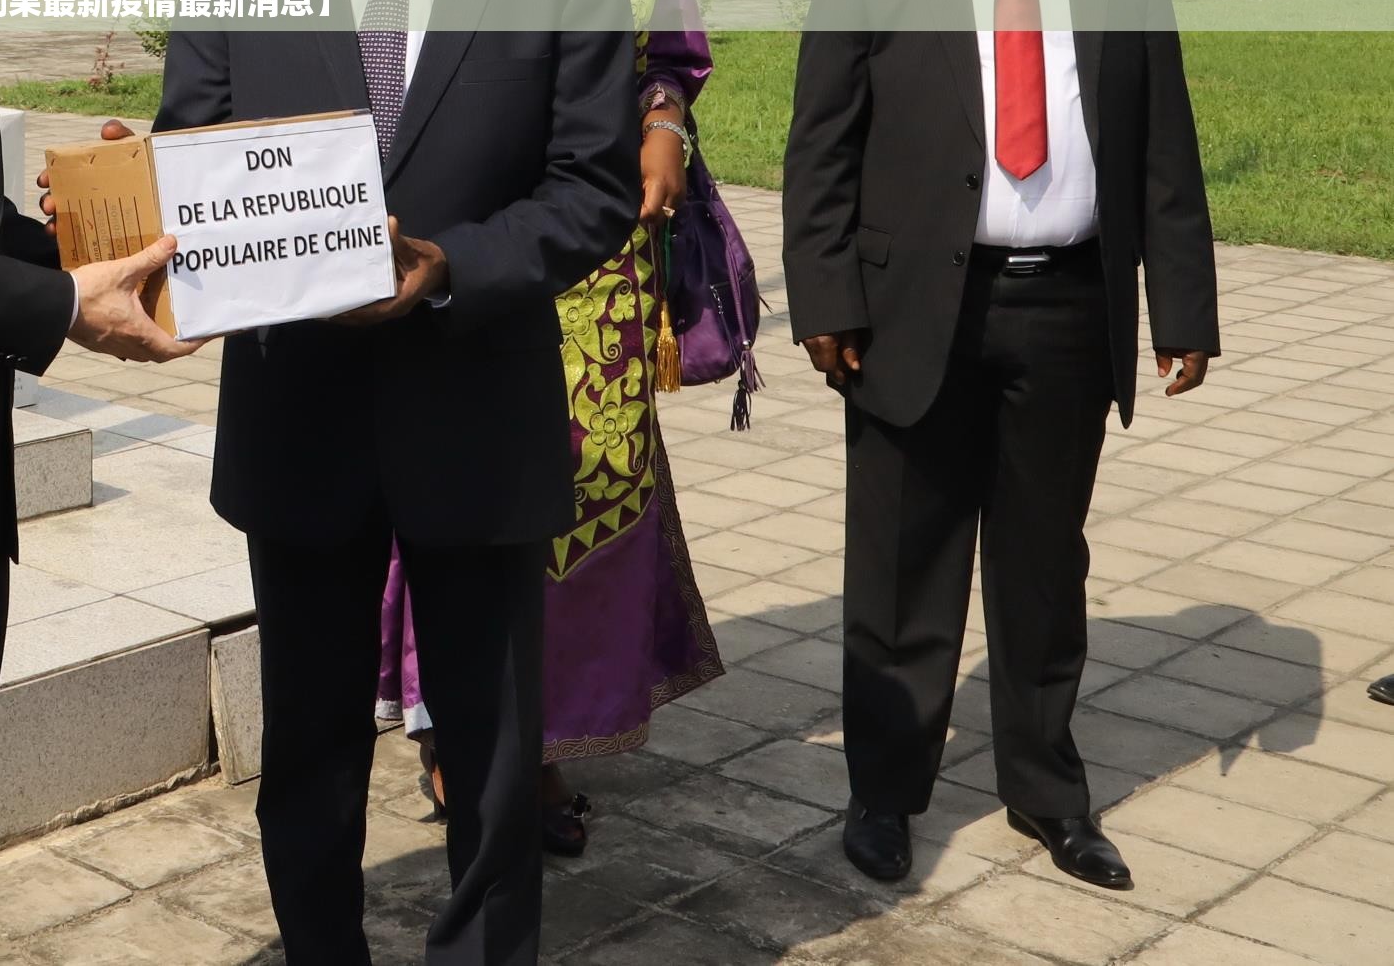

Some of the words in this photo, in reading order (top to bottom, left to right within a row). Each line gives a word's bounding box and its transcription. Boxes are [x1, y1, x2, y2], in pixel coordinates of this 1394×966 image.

[245, 146, 292, 171] DON
[178, 204, 205, 226] DE
[212, 199, 238, 222] LA
[244, 182, 368, 218] REPUBLIQUE
[172, 236, 288, 274] POPULAIRE
[295, 234, 320, 256] DE
[325, 225, 384, 251] CHINE
